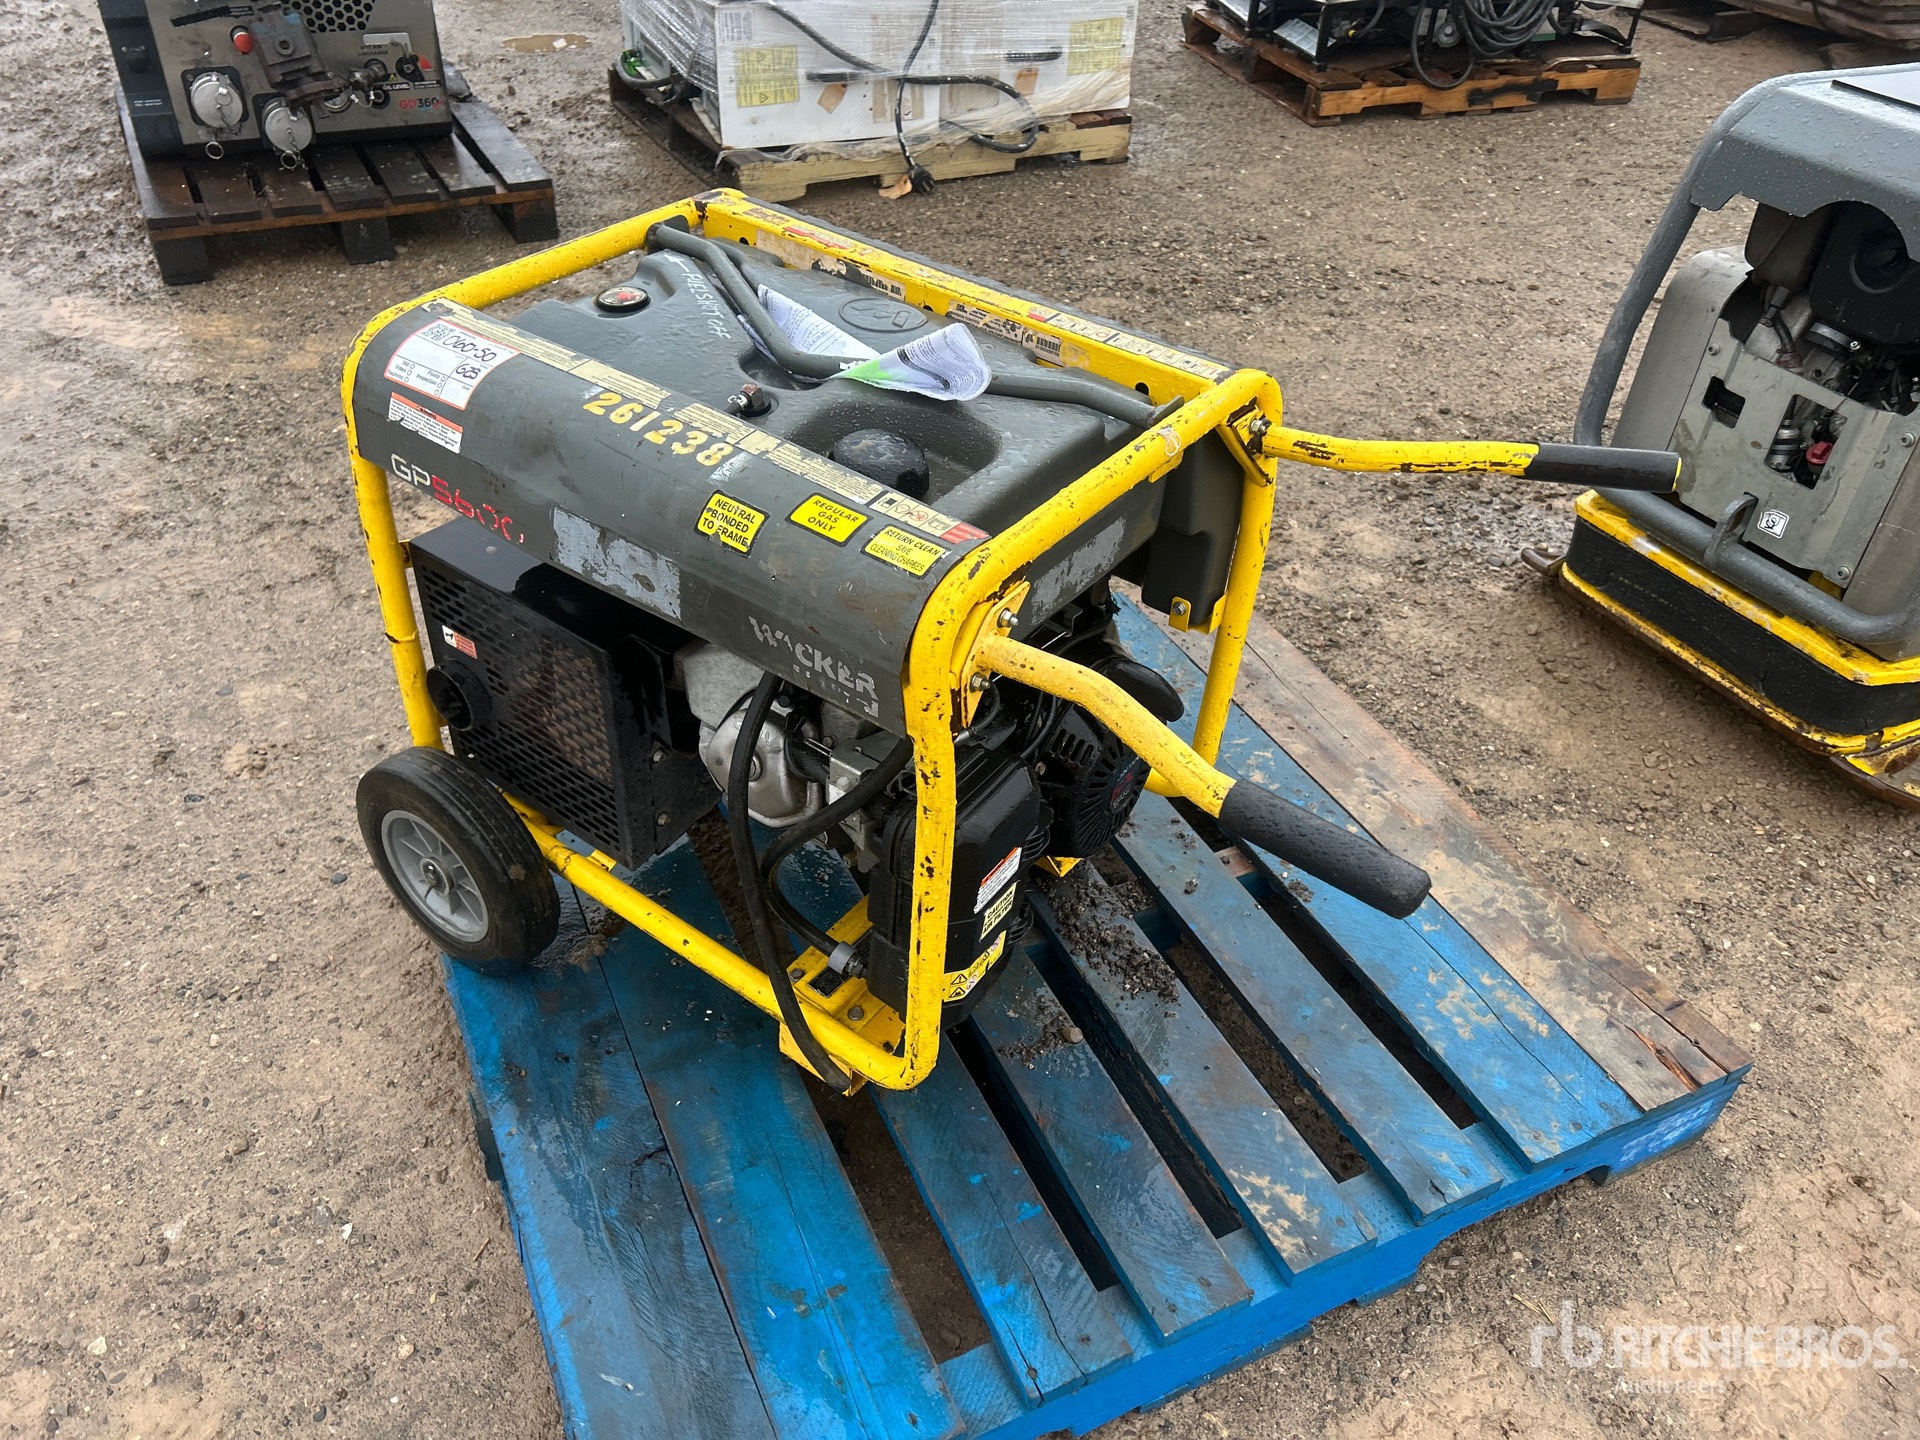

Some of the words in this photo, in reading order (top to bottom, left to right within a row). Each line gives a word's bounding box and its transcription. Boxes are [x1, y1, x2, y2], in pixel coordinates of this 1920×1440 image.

[582, 391, 734, 467] 261238
[710, 508, 749, 533] BONDED
[715, 498, 755, 524] NEUTRAL
[813, 499, 859, 523] REGULAR
[817, 511, 840, 524] GAS
[702, 517, 715, 530] TO
[715, 525, 749, 548] FRAME
[807, 516, 836, 533] ONLY
[885, 529, 913, 545] RETURN
[913, 541, 941, 557] CLEAN
[895, 544, 914, 556] SAVE
[869, 543, 898, 561] CLEANING
[896, 554, 925, 573] CHARGES
